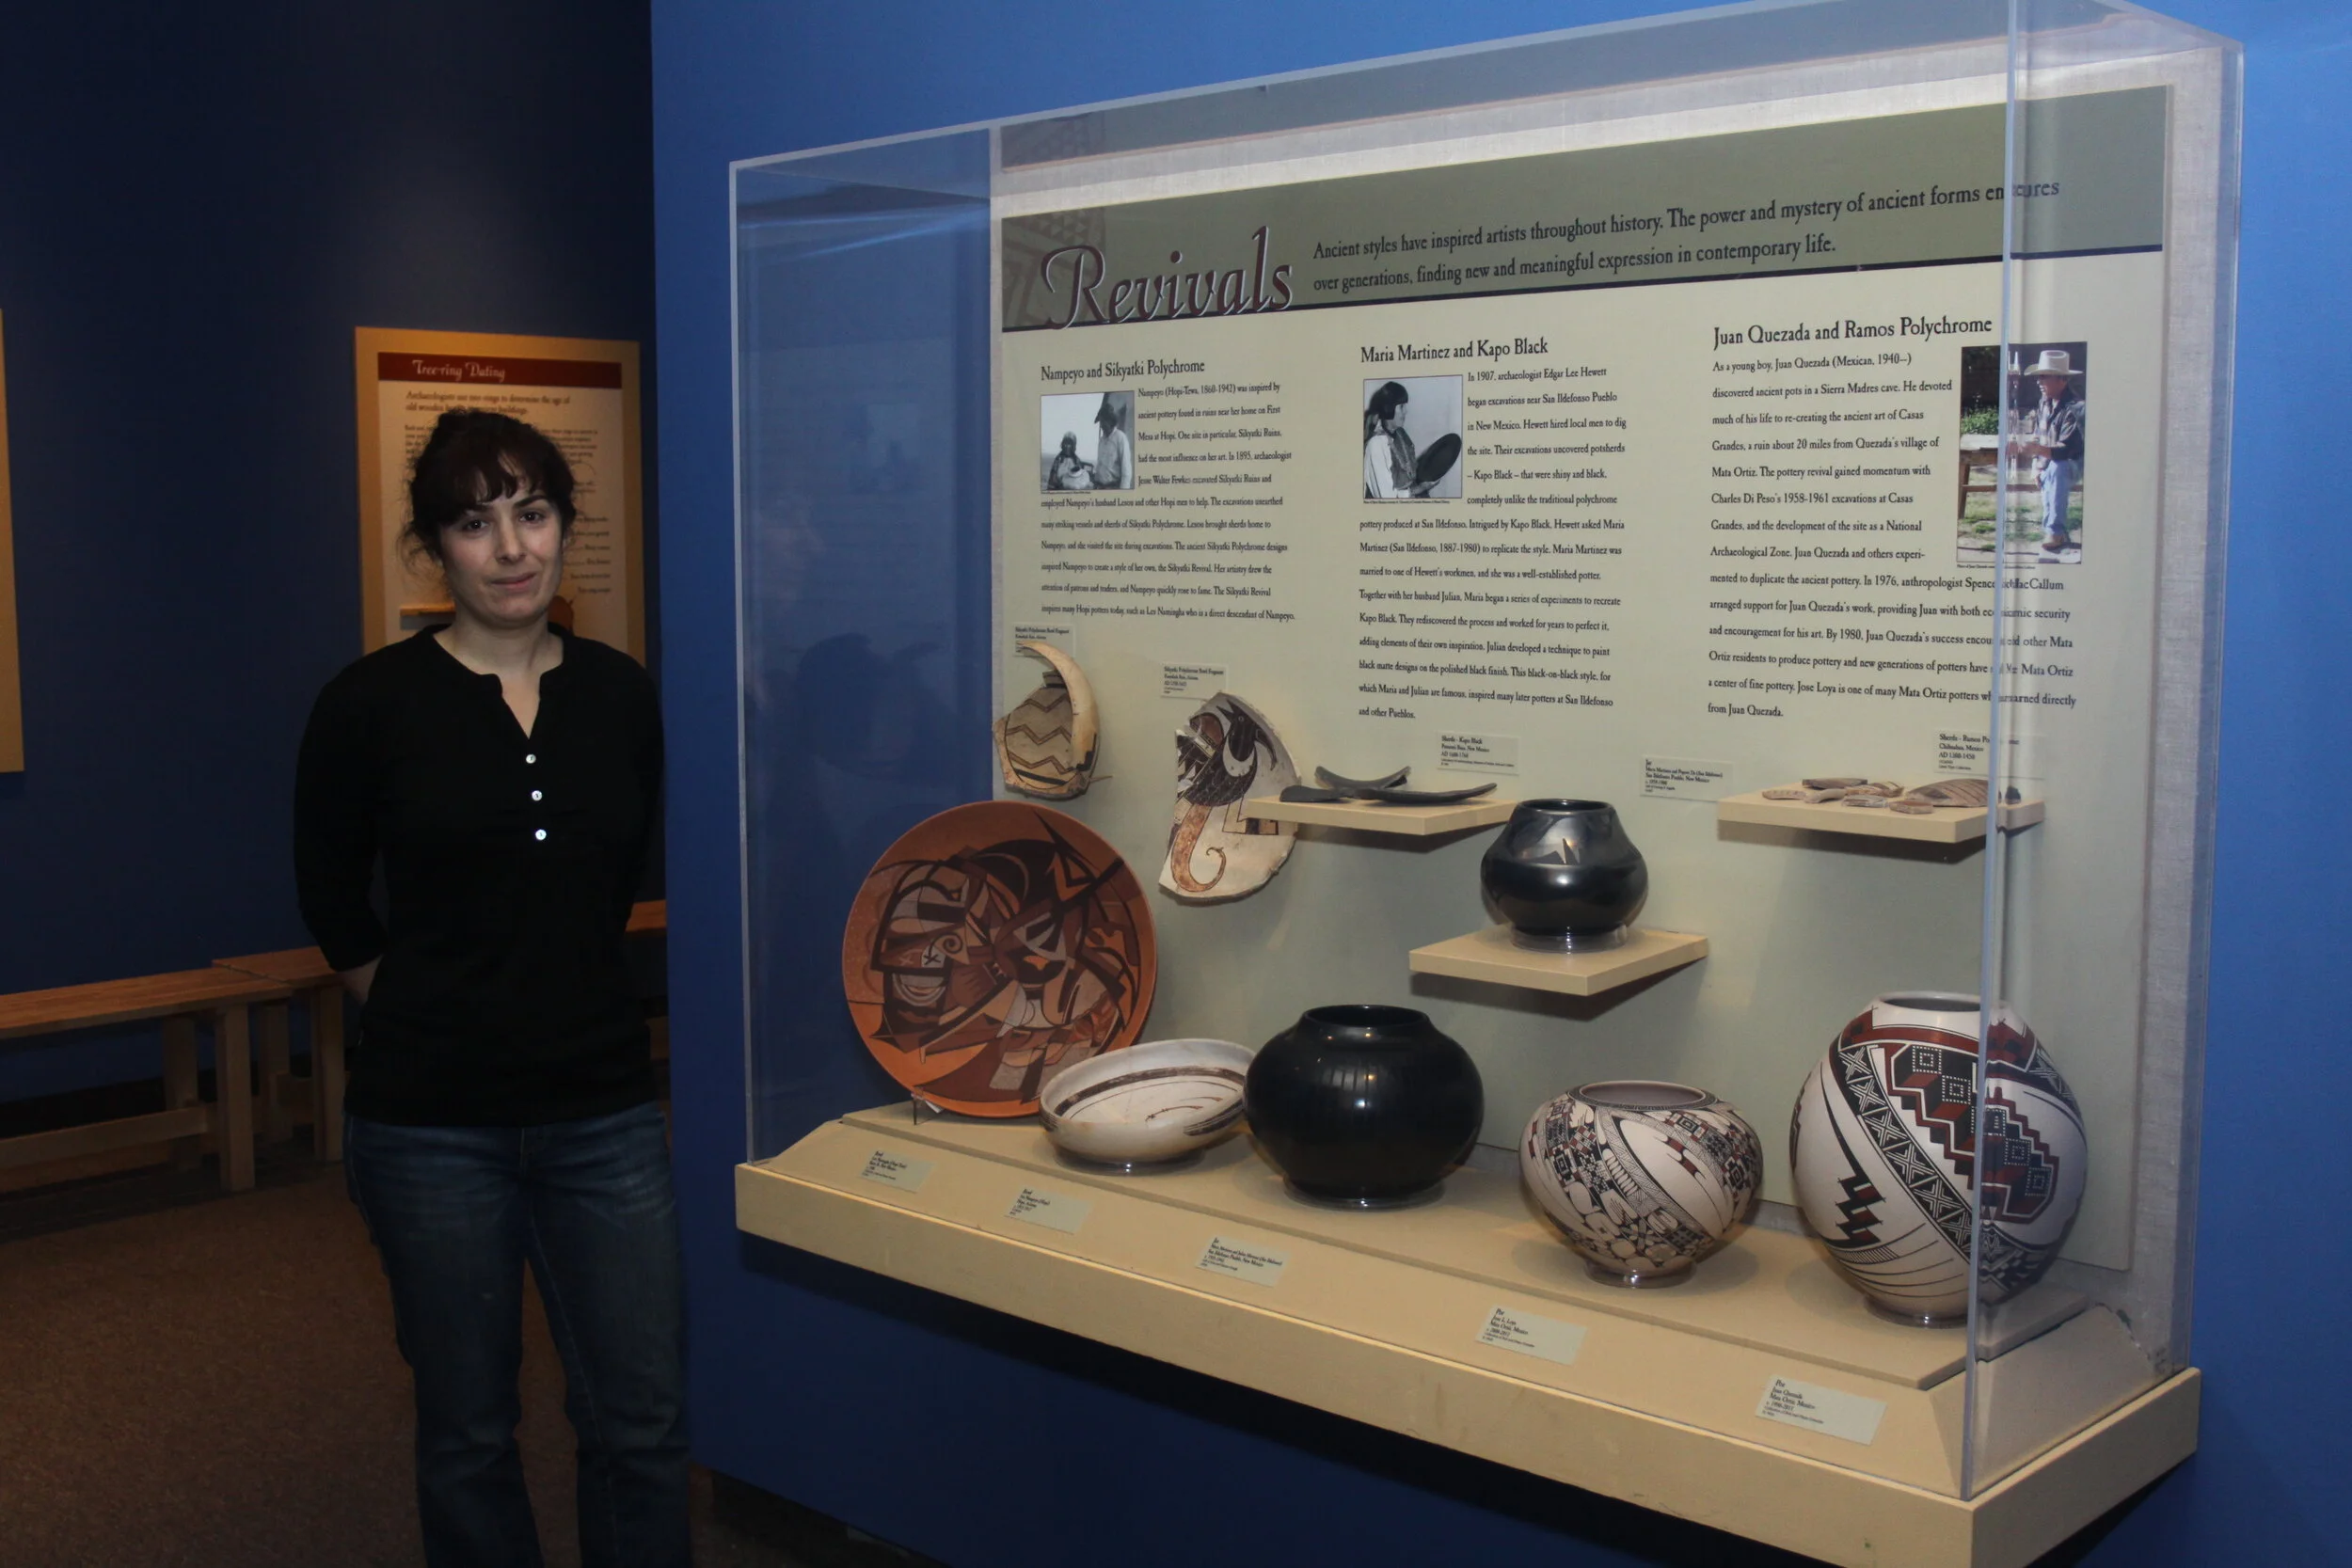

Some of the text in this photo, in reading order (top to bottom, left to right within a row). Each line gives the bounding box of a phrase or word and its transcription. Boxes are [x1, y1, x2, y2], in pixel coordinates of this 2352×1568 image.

[1312, 241, 1359, 259] Ancient
[1363, 235, 1397, 260] styles
[1401, 233, 1427, 251] have
[1431, 226, 1482, 253] inspired
[1486, 225, 1526, 243] artists
[1530, 218, 1606, 242] throughout
[1611, 214, 1662, 236] history.
[1666, 207, 1695, 228] The
[1699, 209, 1745, 232] power
[1750, 199, 1775, 220] and
[1780, 201, 1842, 224] mystery
[1846, 191, 1865, 212] of
[1867, 189, 1925, 211] ancient
[1930, 184, 1979, 205] forms
[1313, 232, 1836, 293] over generations, finding new and meaningful expression in contemporary life.
[1041, 225, 1293, 329] Revivals
[1713, 315, 1992, 351] Juan Quezada and Ramos Polychrome
[1360, 337, 1548, 362] Maria Martinez and Kapo Black
[412, 359, 505, 384] Tree-ring Dating
[1041, 358, 1204, 385] Nampeyo and Sikyatki Polychrome
[1712, 361, 1724, 372] As
[1731, 363, 1755, 374] young
[1774, 357, 1791, 372] Juan
[1794, 356, 1830, 368] Quezada
[1468, 372, 1474, 382] In
[1498, 369, 1541, 382] archaeologist
[1543, 368, 1564, 381] Edgar
[1565, 367, 1578, 377] Lee
[1581, 366, 1606, 376] Hewett
[1468, 396, 1486, 408] began
[1487, 395, 1525, 405] excavations
[1542, 393, 1554, 404] San
[1557, 392, 1590, 403] Ildefonso
[1592, 391, 1617, 402] Pueblo
[1712, 408, 1923, 424] much of his life to re-creating the ancient art of Casas
[1712, 467, 1731, 477] Mata
[1759, 466, 1774, 477] The
[1776, 468, 1804, 480] pottery
[1807, 466, 1832, 476] revival
[1835, 465, 1860, 479] gained
[1863, 467, 1910, 476] momentum
[1912, 464, 1931, 475] with
[1710, 492, 1740, 503] Charles
[1743, 492, 1754, 503] Di
[1784, 492, 1828, 503] 1958-1961
[1831, 493, 1876, 503] excavations
[1887, 491, 1913, 503] Casas
[1359, 542, 1388, 552] Martinez
[1389, 542, 1405, 553] (San
[1490, 544, 1518, 556] replicate
[1520, 544, 1531, 553] the
[1552, 544, 1573, 554] Maria
[1575, 544, 1607, 554] Martinez
[1710, 546, 1767, 560] Archaeological
[1794, 546, 1811, 560] Juan
[1814, 546, 1849, 558] Quezada
[1851, 547, 1865, 558] and
[1867, 547, 1893, 559] others
[1895, 548, 1925, 562] experi-
[1359, 706, 1369, 716] and
[1370, 706, 1387, 717] other
[1708, 702, 1783, 717] from Juan Quezada.
